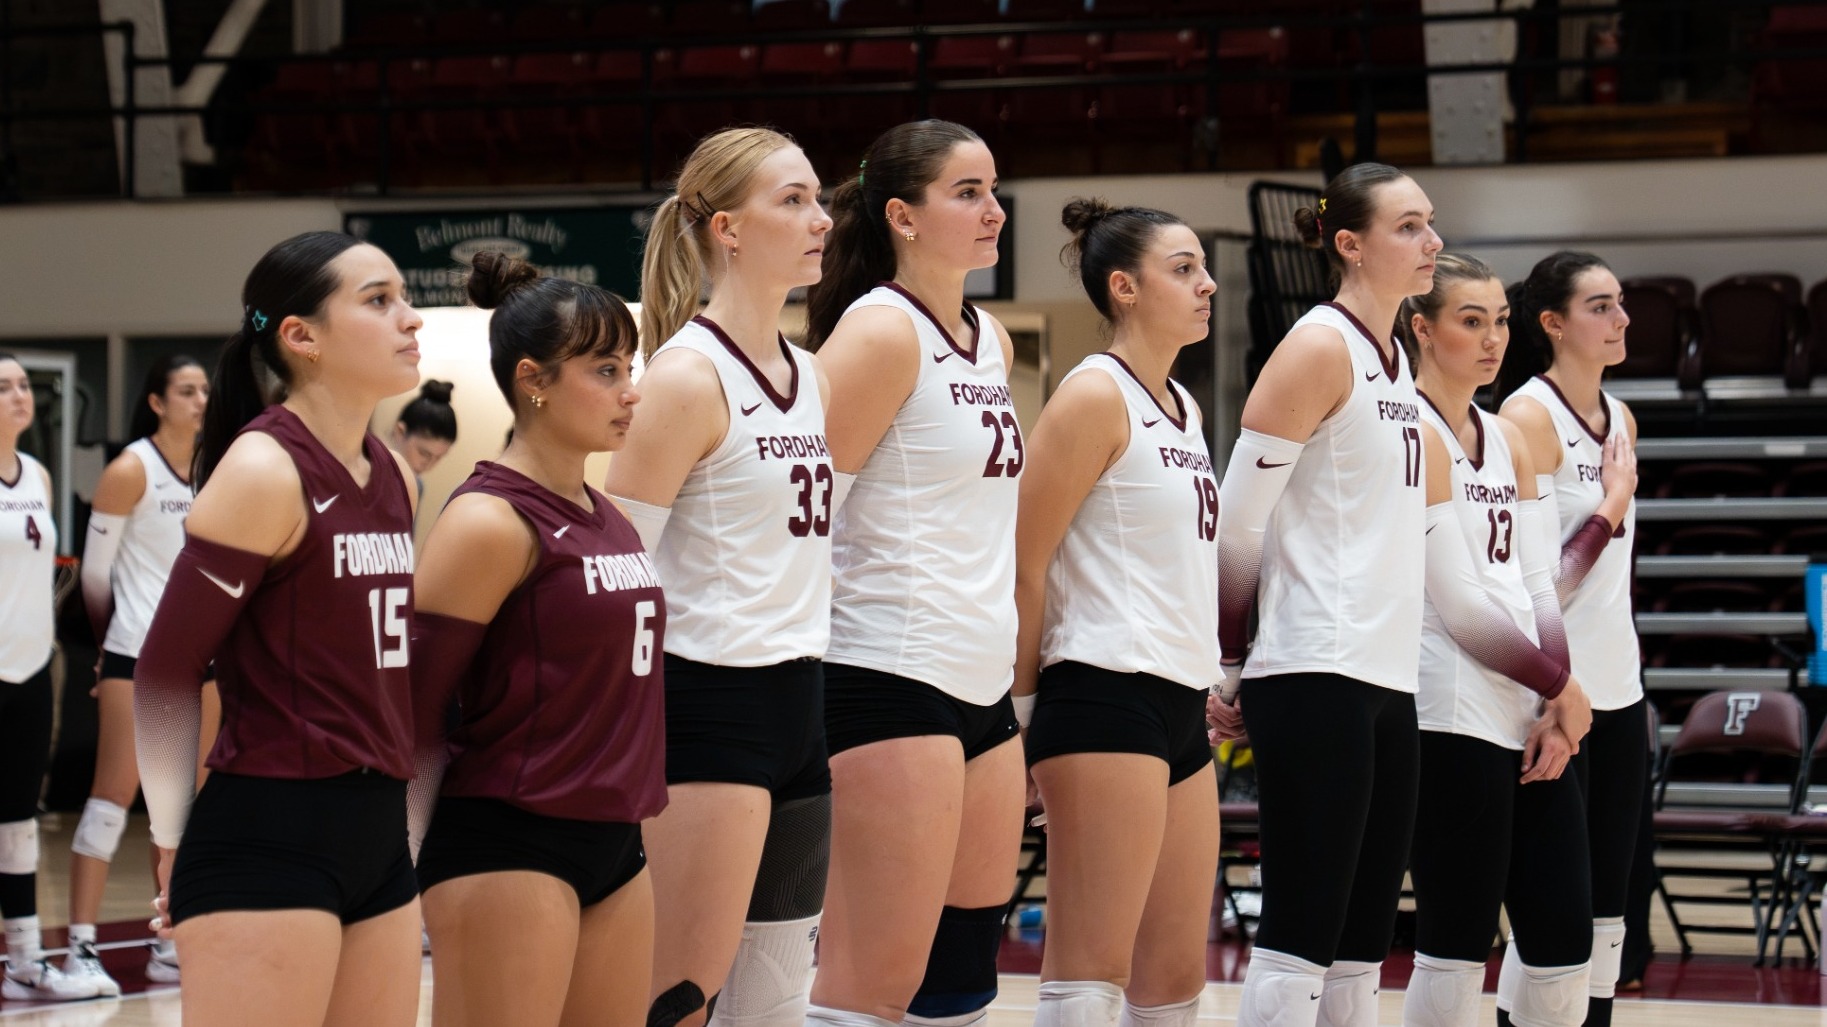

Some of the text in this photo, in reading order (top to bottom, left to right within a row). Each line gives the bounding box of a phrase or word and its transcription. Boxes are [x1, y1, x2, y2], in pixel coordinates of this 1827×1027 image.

[415, 213, 567, 252] Belmont Realty
[756, 435, 831, 460] FORDHA
[981, 411, 1024, 478] 23
[1402, 426, 1421, 487] 17
[0, 499, 45, 513] ORDHAM
[160, 499, 192, 513] FORD
[788, 463, 833, 537] 33
[1193, 475, 1219, 542] 19
[1464, 482, 1517, 504] FORDHAM
[26, 515, 42, 550] 4
[1487, 508, 1513, 564] 13
[582, 552, 661, 595] FORDHA
[369, 588, 409, 669] 15
[631, 601, 656, 677] 6
[1723, 692, 1761, 735] F
